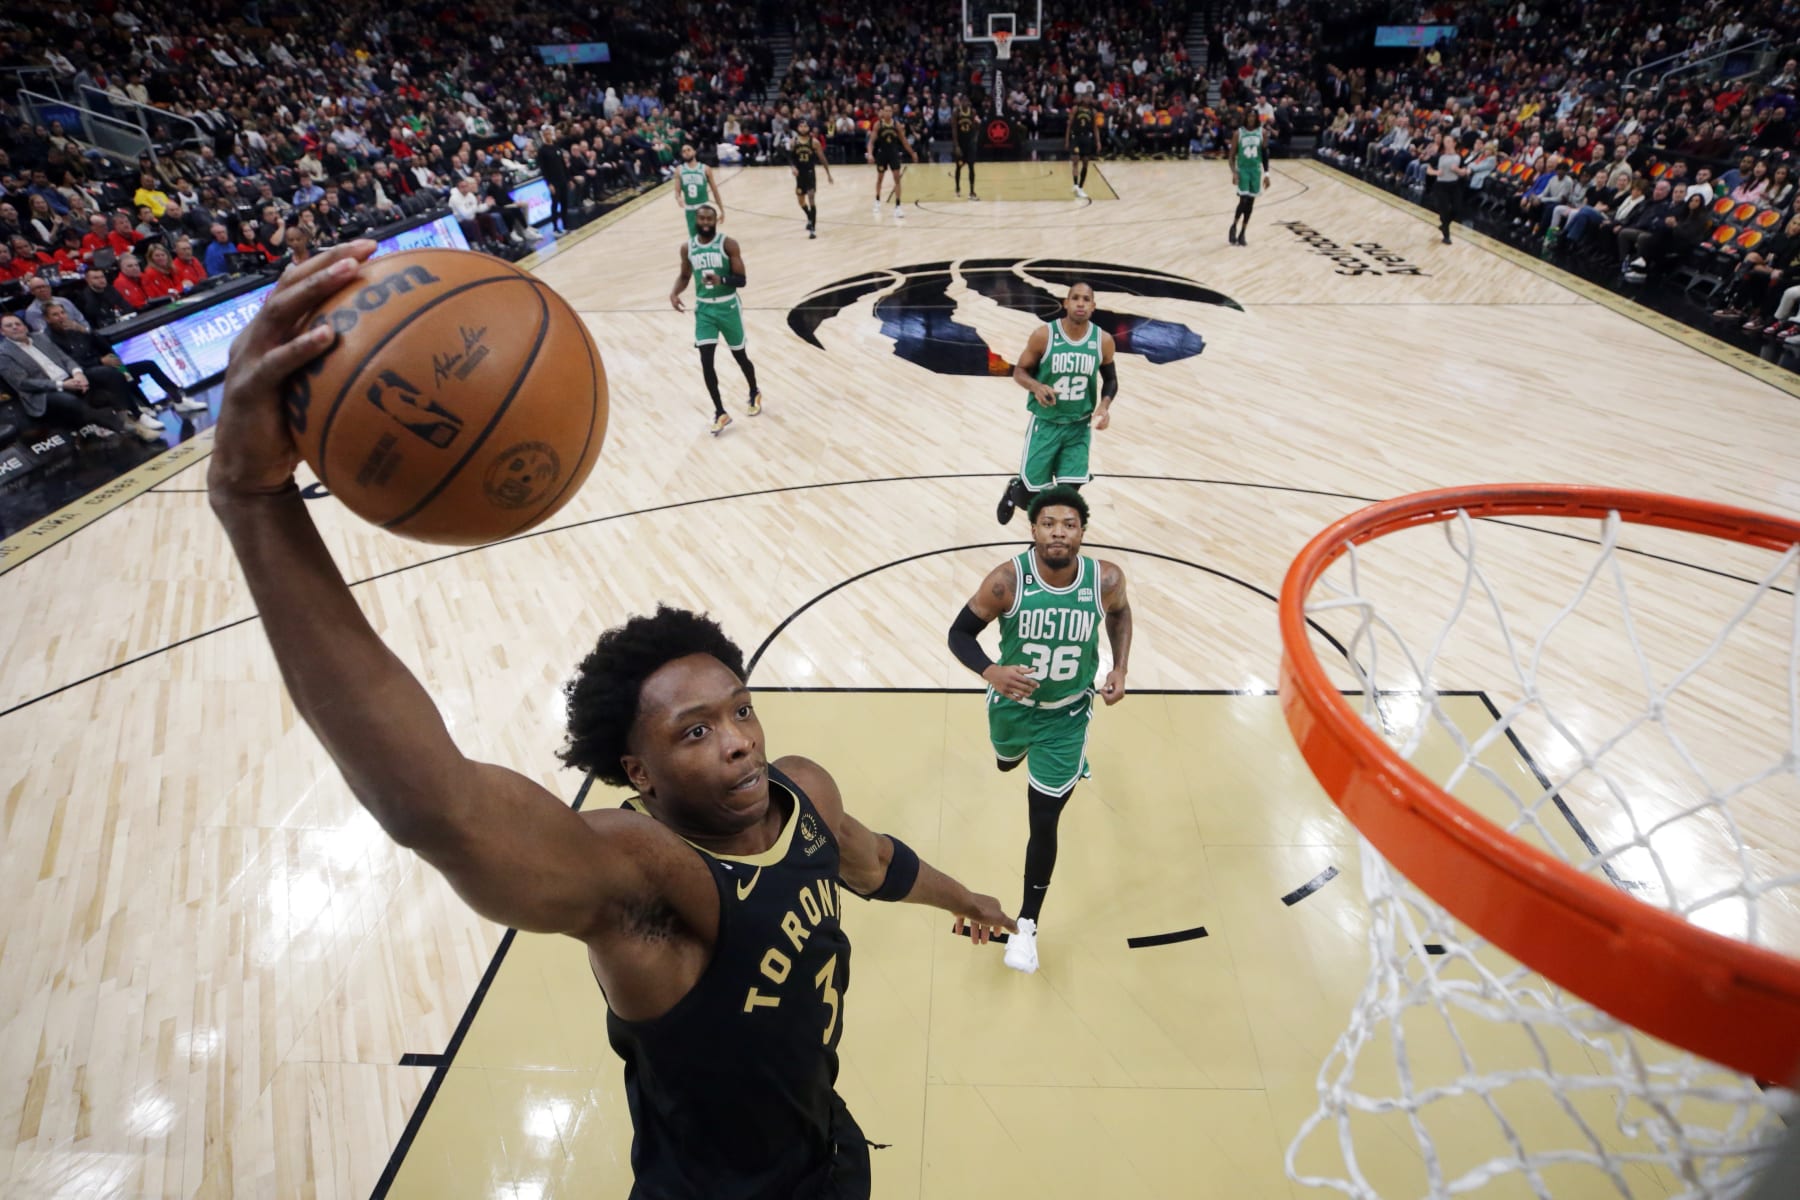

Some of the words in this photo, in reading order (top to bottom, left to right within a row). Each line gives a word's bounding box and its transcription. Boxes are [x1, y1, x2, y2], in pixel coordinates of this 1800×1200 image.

[1243, 146, 1258, 159] 44
[691, 252, 723, 270] BOSTON
[1352, 243, 1433, 277] Arena
[189, 311, 242, 346] MADE
[1052, 352, 1096, 376] BOSTON
[1053, 375, 1089, 401] 42
[31, 434, 66, 455] AXE
[1025, 574, 1033, 585] 6
[1018, 607, 1095, 643] BOSTON
[1019, 642, 1082, 682] 36
[804, 843, 818, 857] Sun
[815, 835, 827, 848] Life
[743, 878, 841, 1013] TORONT
[815, 952, 838, 1046] 3
